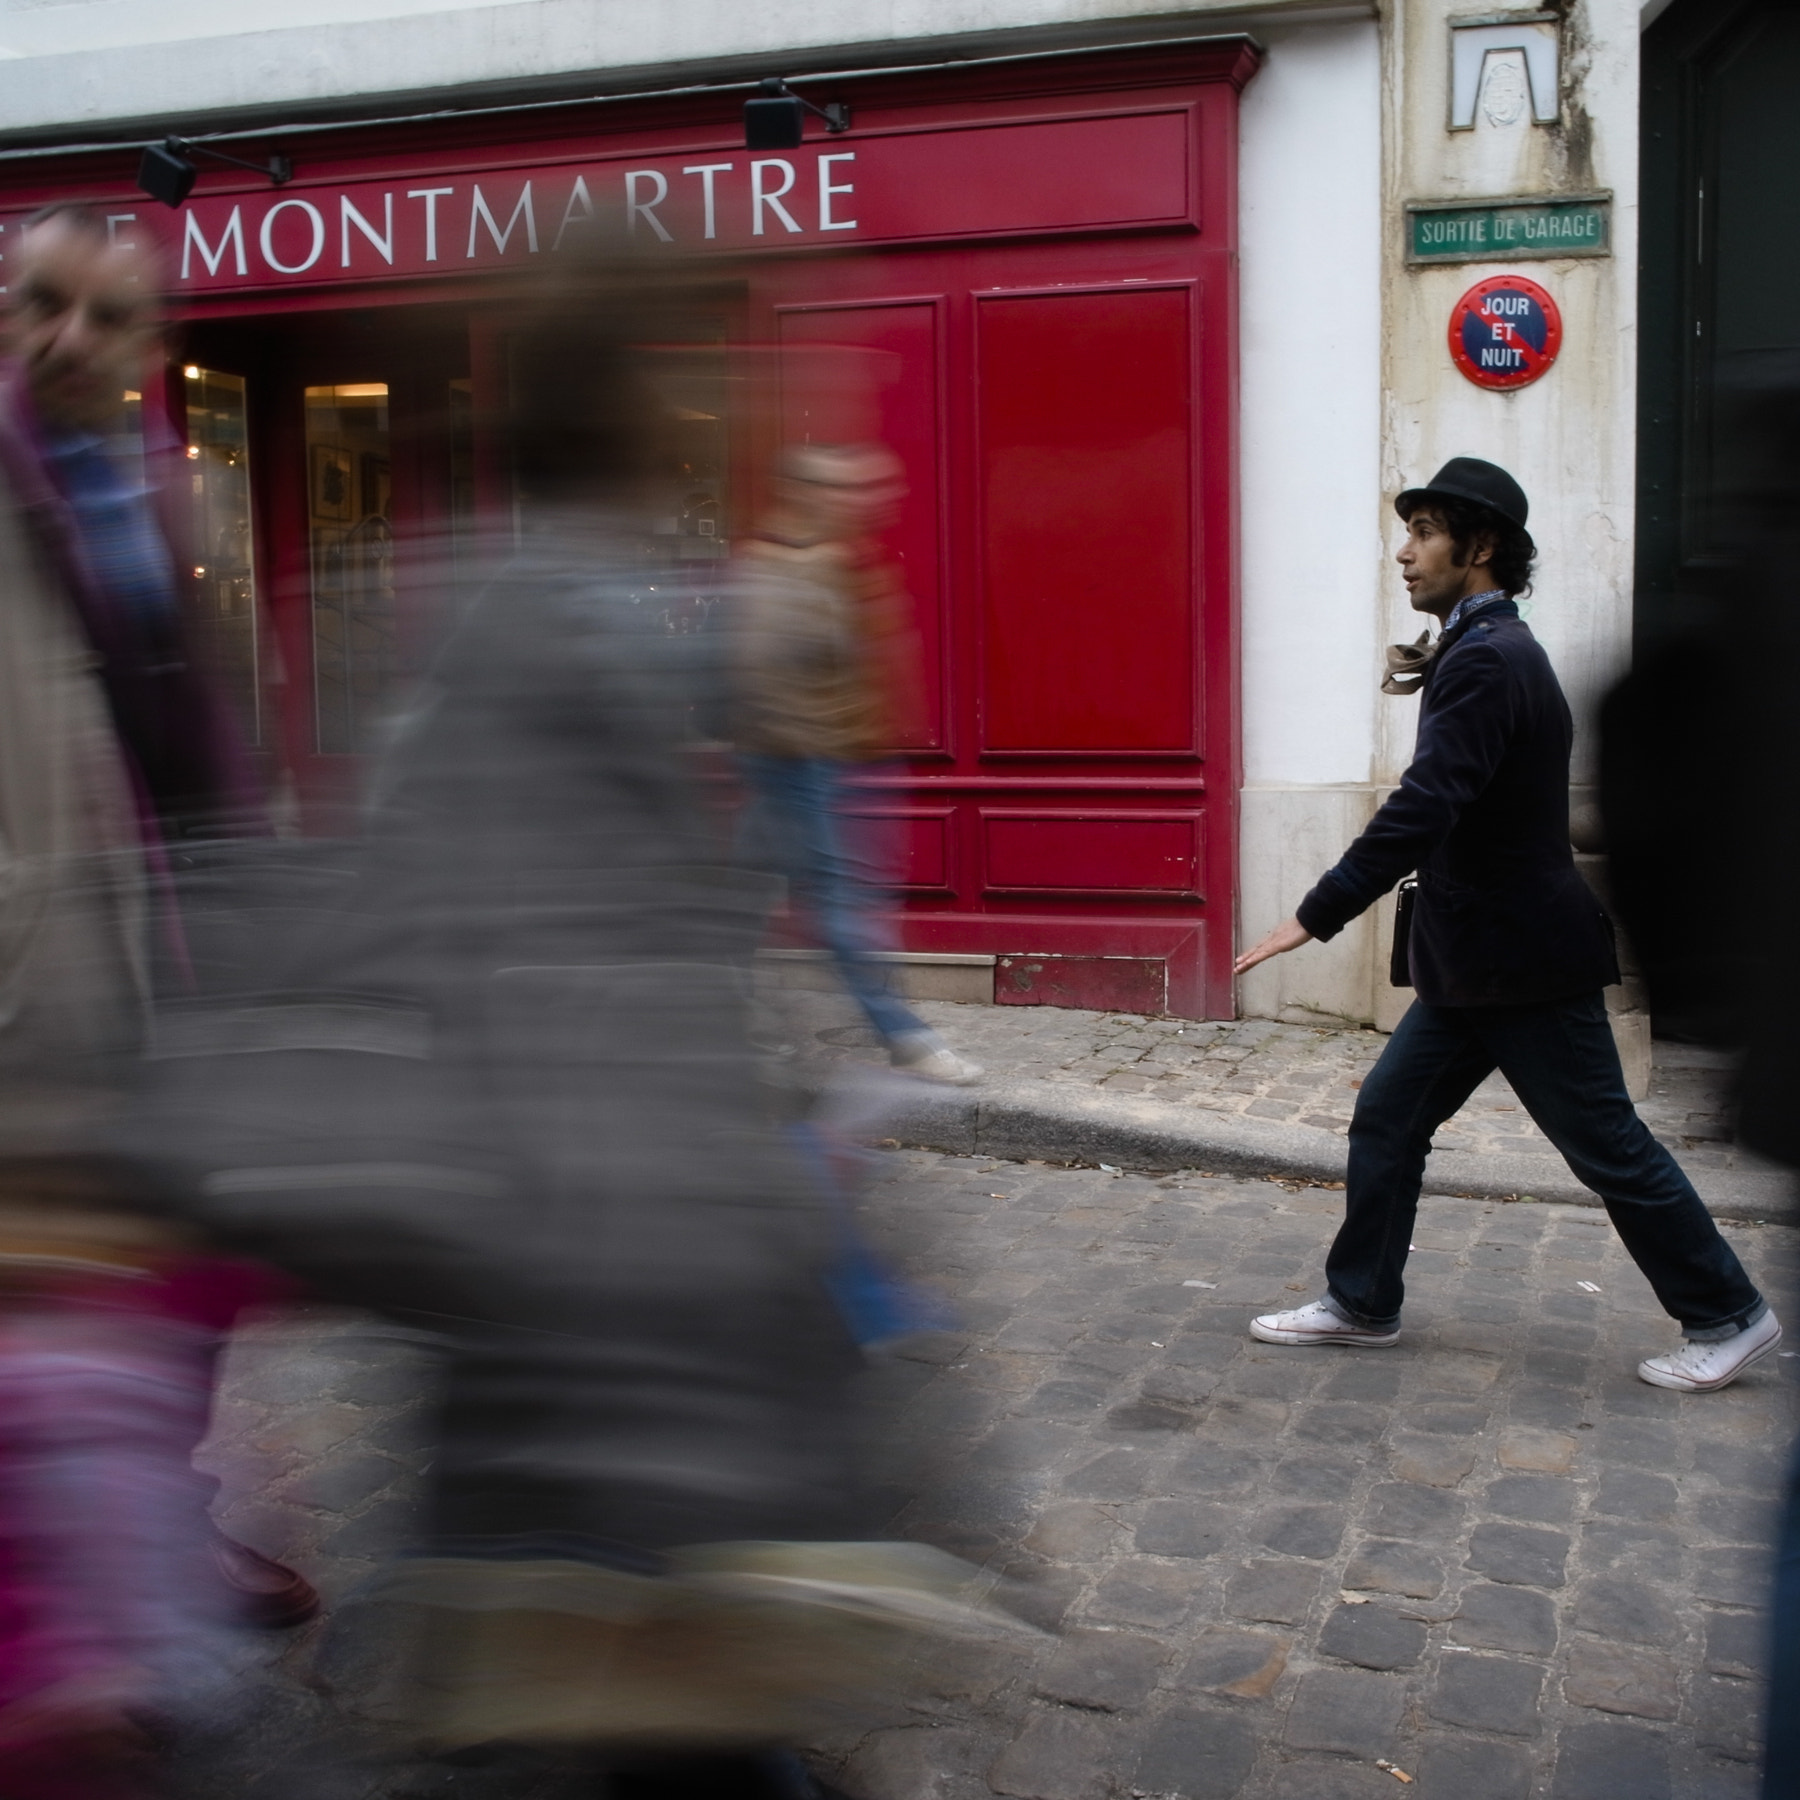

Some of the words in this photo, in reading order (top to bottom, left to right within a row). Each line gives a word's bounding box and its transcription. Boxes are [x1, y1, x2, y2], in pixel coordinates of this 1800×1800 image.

[181, 152, 858, 280] MONTMARTRE
[1421, 219, 1487, 244] SORTIE
[1493, 218, 1515, 241] DE
[1524, 214, 1595, 239] GARAGE
[1480, 297, 1530, 316] JOUR
[1491, 322, 1516, 341] ET
[1480, 348, 1524, 367] NUIT
